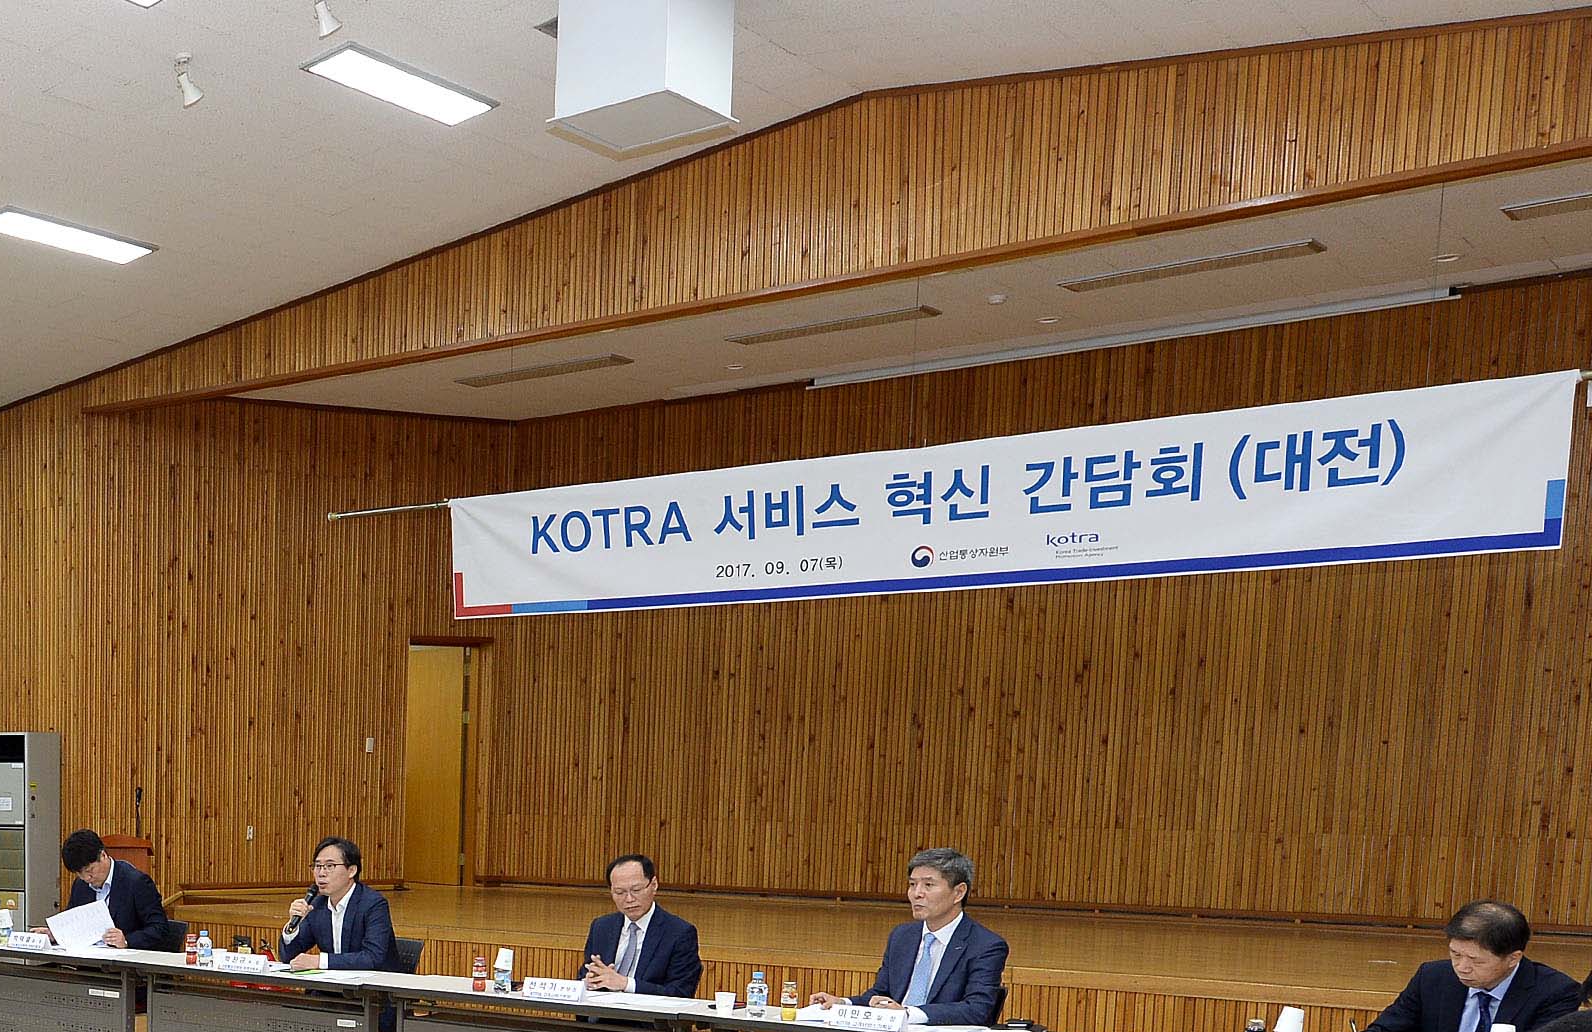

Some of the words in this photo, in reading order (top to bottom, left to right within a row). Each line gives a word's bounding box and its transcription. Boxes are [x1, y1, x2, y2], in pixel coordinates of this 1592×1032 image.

[531, 501, 693, 555] KOTRA
[714, 484, 860, 541] 서비스
[885, 464, 991, 526] 혁신
[1022, 442, 1204, 515] 간담회
[1228, 418, 1407, 500] (대전)
[1046, 532, 1100, 547] kotra
[939, 546, 1009, 561] 산업통상자원부
[715, 563, 756, 579] 2017.
[764, 561, 790, 577] 09.
[799, 555, 844, 573] 07(목)
[838, 1008, 872, 1020] 이민호
